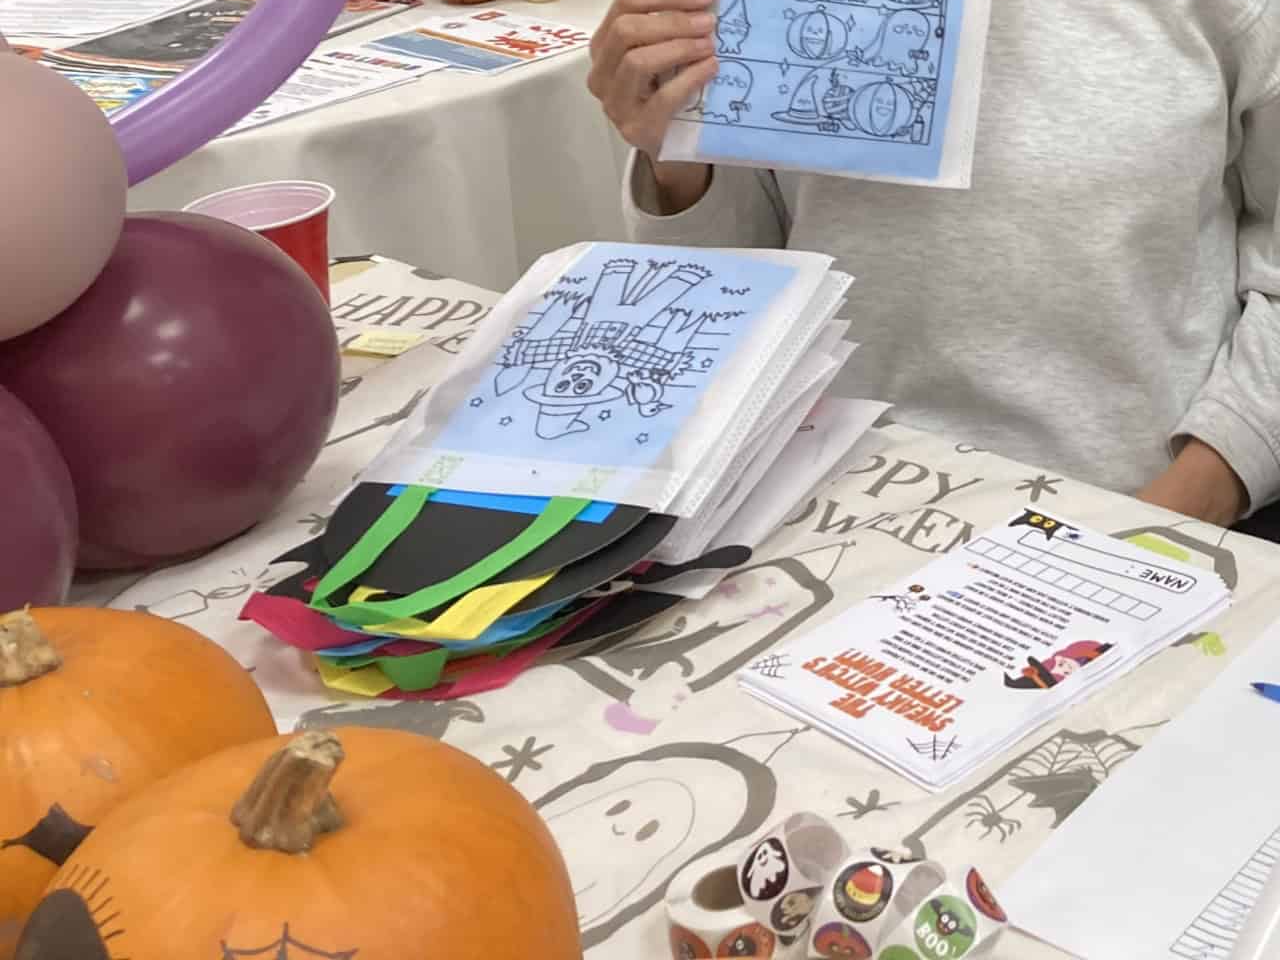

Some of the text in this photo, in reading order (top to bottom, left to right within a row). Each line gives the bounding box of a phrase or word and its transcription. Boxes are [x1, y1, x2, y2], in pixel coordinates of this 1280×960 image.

[1139, 568, 1191, 590] NAME
[801, 655, 955, 733] SNEAKY WITCH'S
[832, 647, 966, 714] LETTER HUNT!
[829, 692, 876, 720] THE
